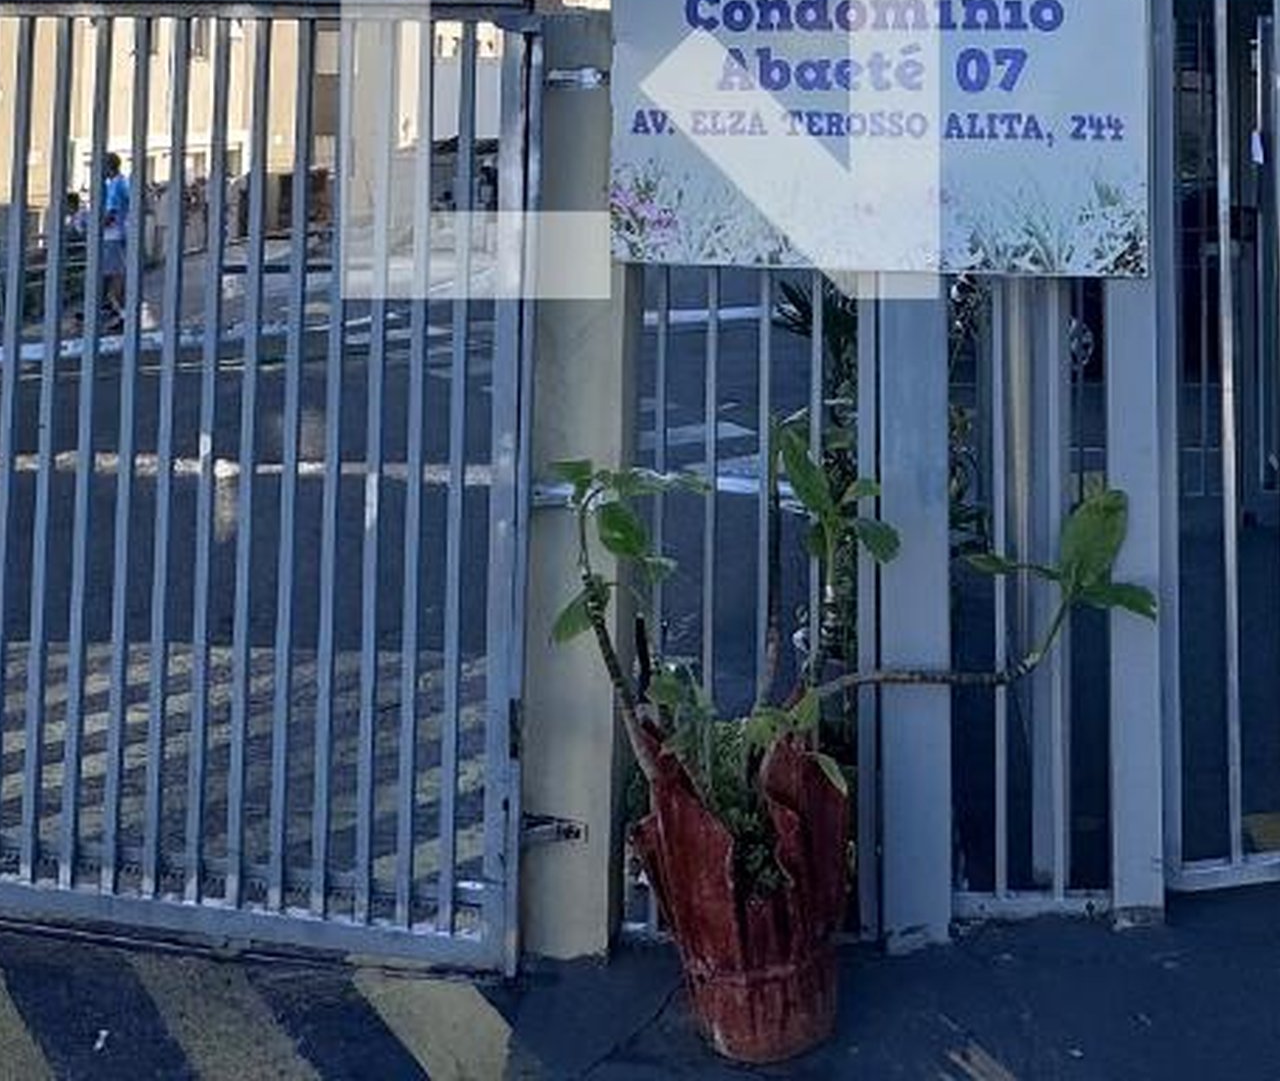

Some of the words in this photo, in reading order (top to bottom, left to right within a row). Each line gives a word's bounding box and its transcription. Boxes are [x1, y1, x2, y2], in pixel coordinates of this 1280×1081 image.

[716, 44, 926, 93] Abaeté
[955, 47, 1029, 93] 07
[631, 109, 676, 137] AV.
[690, 109, 768, 137] ELZA
[785, 110, 929, 138] TEROSSO
[944, 111, 1055, 146] ALITA,
[1069, 114, 1125, 141] 244
